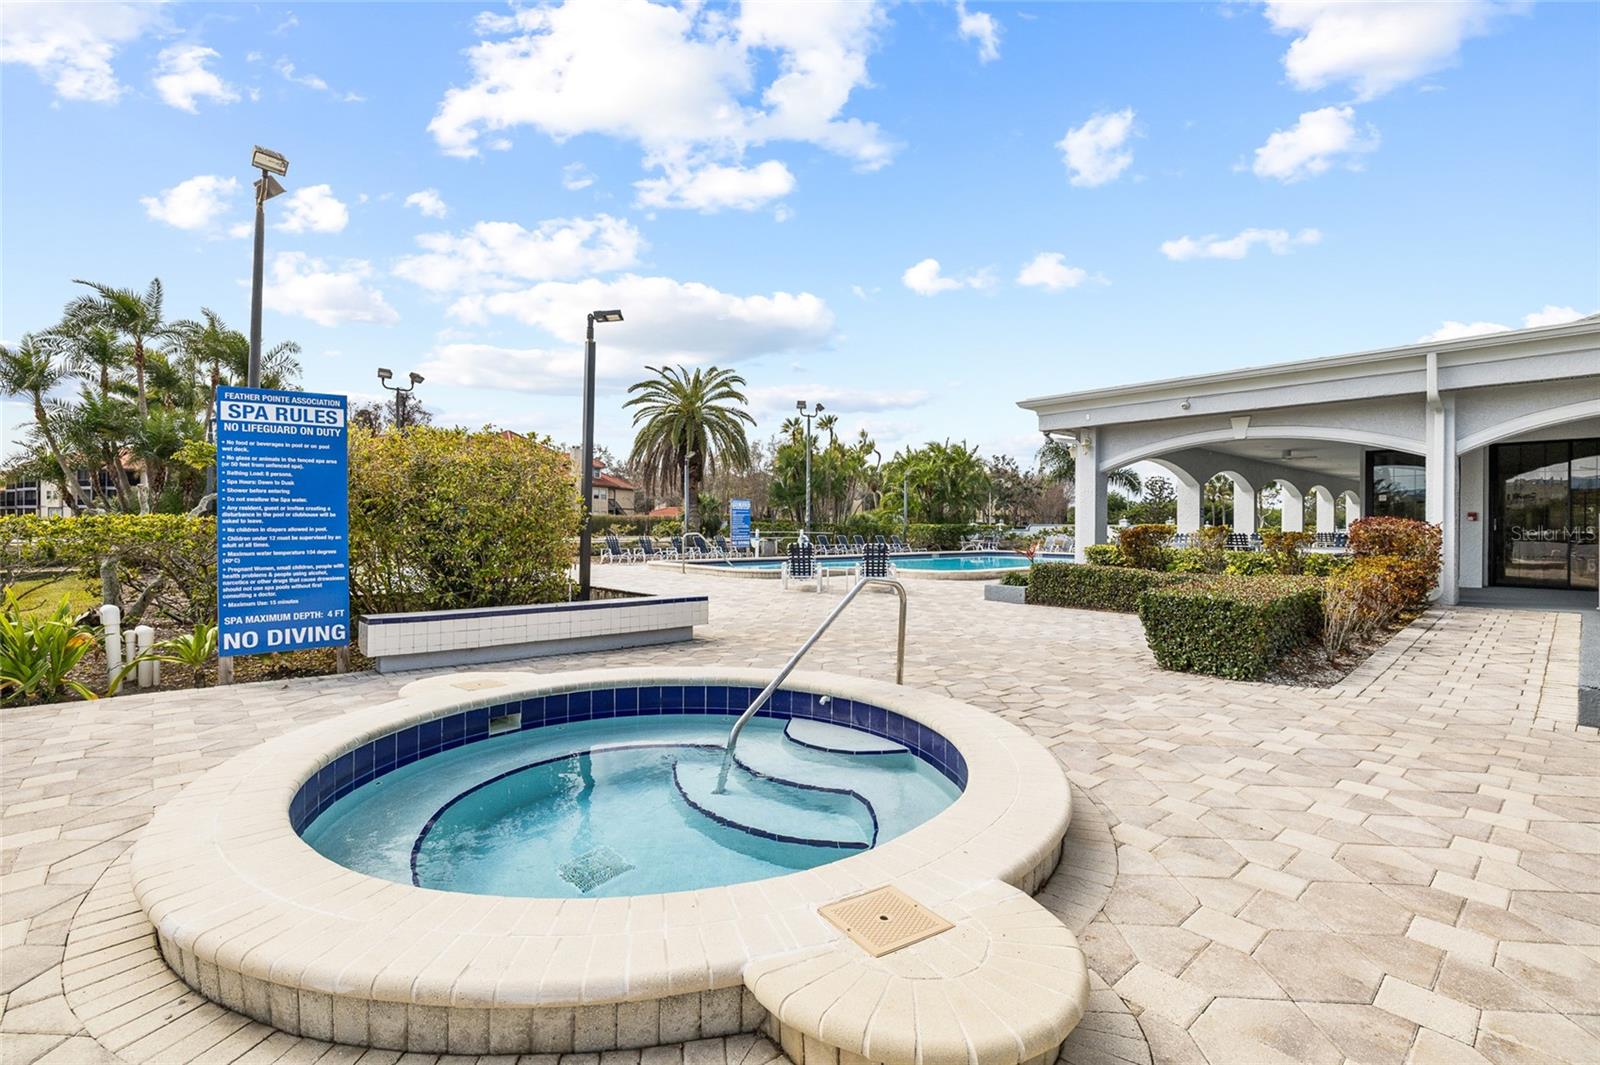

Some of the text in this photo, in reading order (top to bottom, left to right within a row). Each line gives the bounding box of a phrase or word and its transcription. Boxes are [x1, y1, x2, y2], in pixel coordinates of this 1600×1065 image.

[224, 392, 340, 407] FEATHER POINTE ASSOCIATION
[228, 404, 338, 424] SPA RULES
[224, 422, 341, 436] NO LIFEGUARD ON DUTY
[224, 616, 243, 625] SPA
[245, 613, 290, 624] MAXIMUM
[294, 611, 324, 620] DEPTH:
[335, 609, 344, 617] FT
[224, 624, 346, 650] NO DIVING
